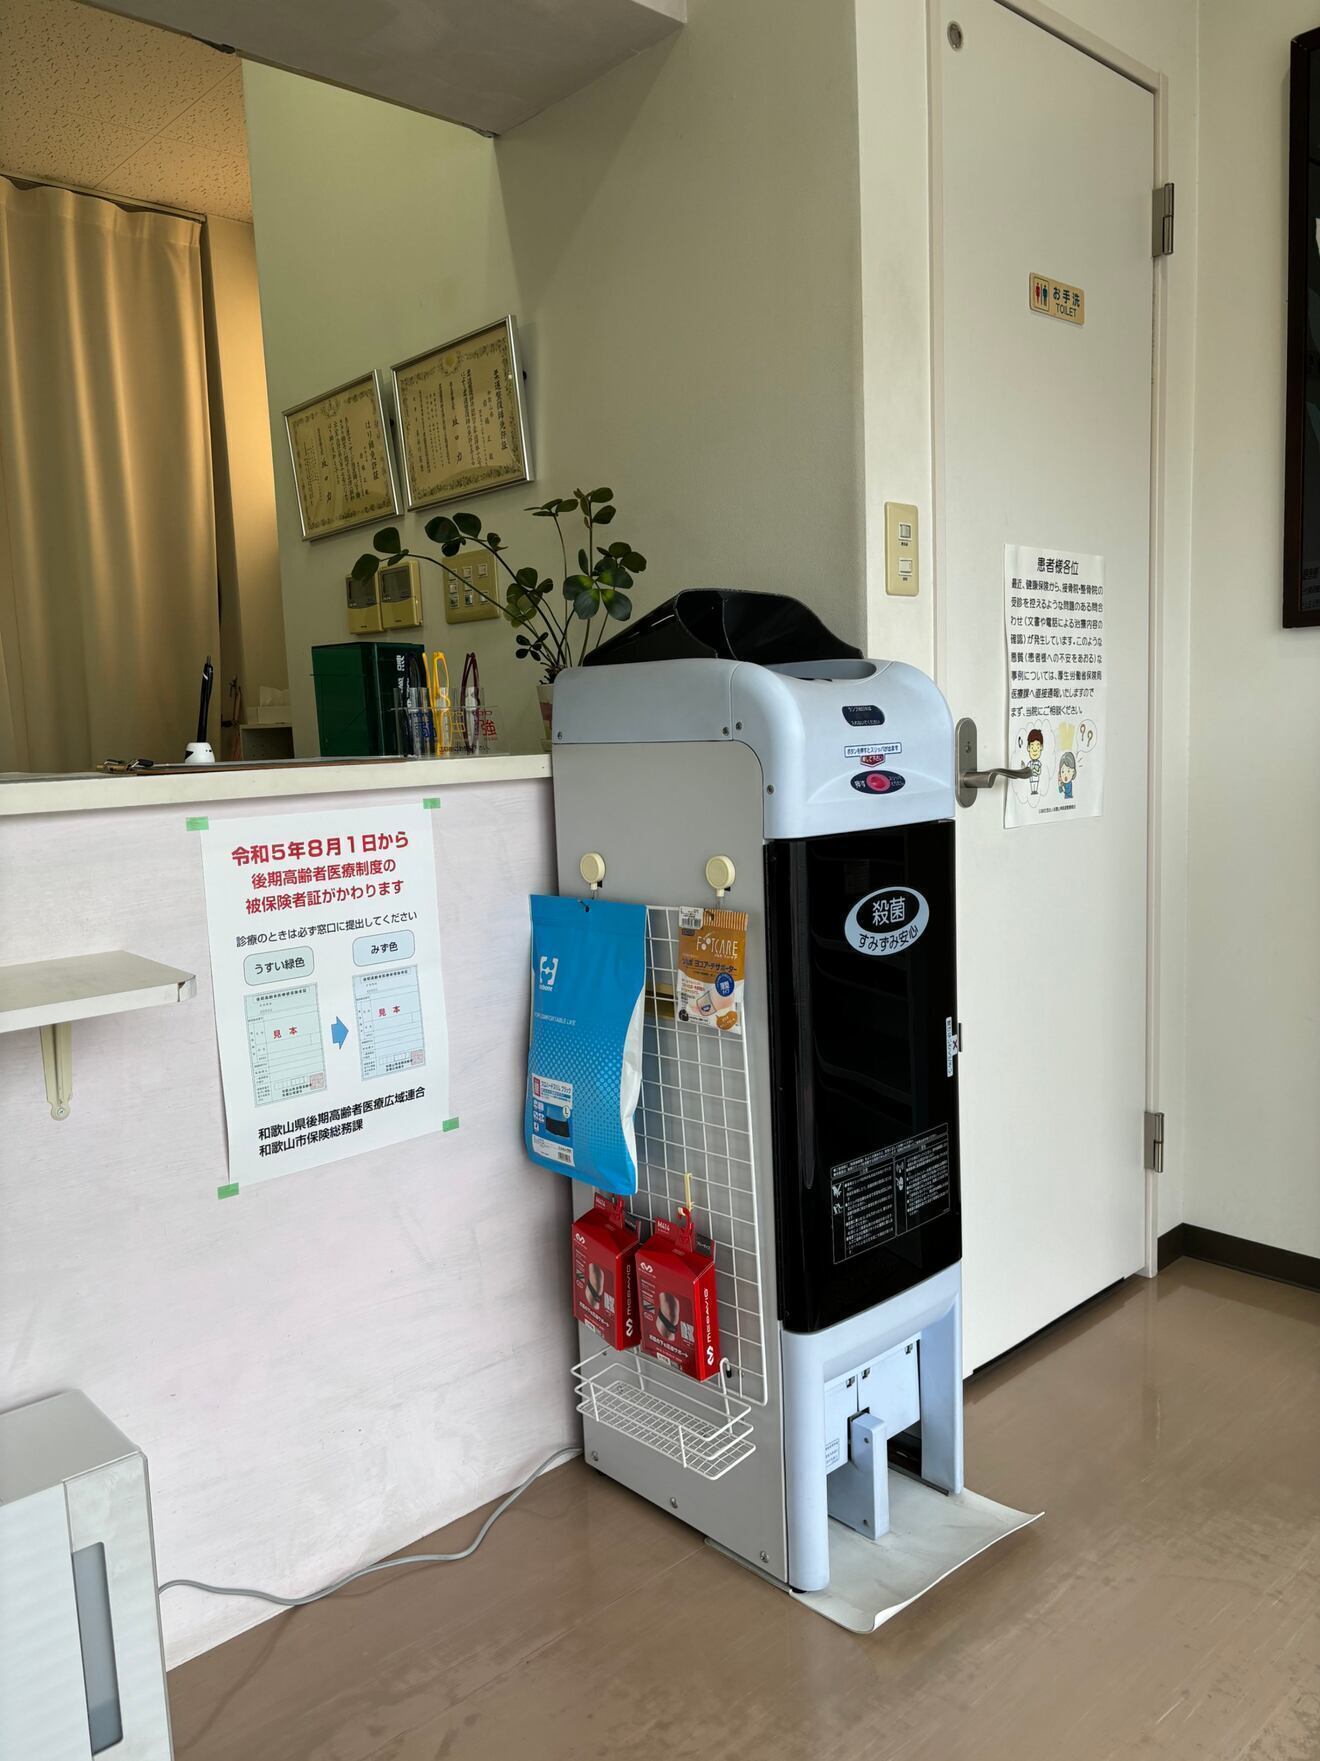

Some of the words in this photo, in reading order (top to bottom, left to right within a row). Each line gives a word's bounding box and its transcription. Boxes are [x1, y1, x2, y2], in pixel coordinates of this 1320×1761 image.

[1053, 287, 1080, 308] お手洗
[1056, 303, 1076, 317] TOILET
[1037, 557, 1079, 575] 患者様各位
[232, 831, 409, 866] 令和5年8月1日から
[251, 859, 396, 890] 後期高齢者医療制度の
[245, 880, 404, 915] 被保険者証がかわります
[872, 896, 906, 926] 殺菌
[236, 912, 418, 948] 診療のときは必ず窓口に提出してください
[858, 924, 919, 952] すみずみ安心
[370, 942, 398, 955] みず色
[255, 958, 305, 974] うすい緑色
[378, 1005, 401, 1017] 見本
[273, 1026, 298, 1039] 見本
[258, 1086, 426, 1141] 和歌山県後期高齢者医療広域連合
[259, 1118, 364, 1157] 和歌山市保険総務課
